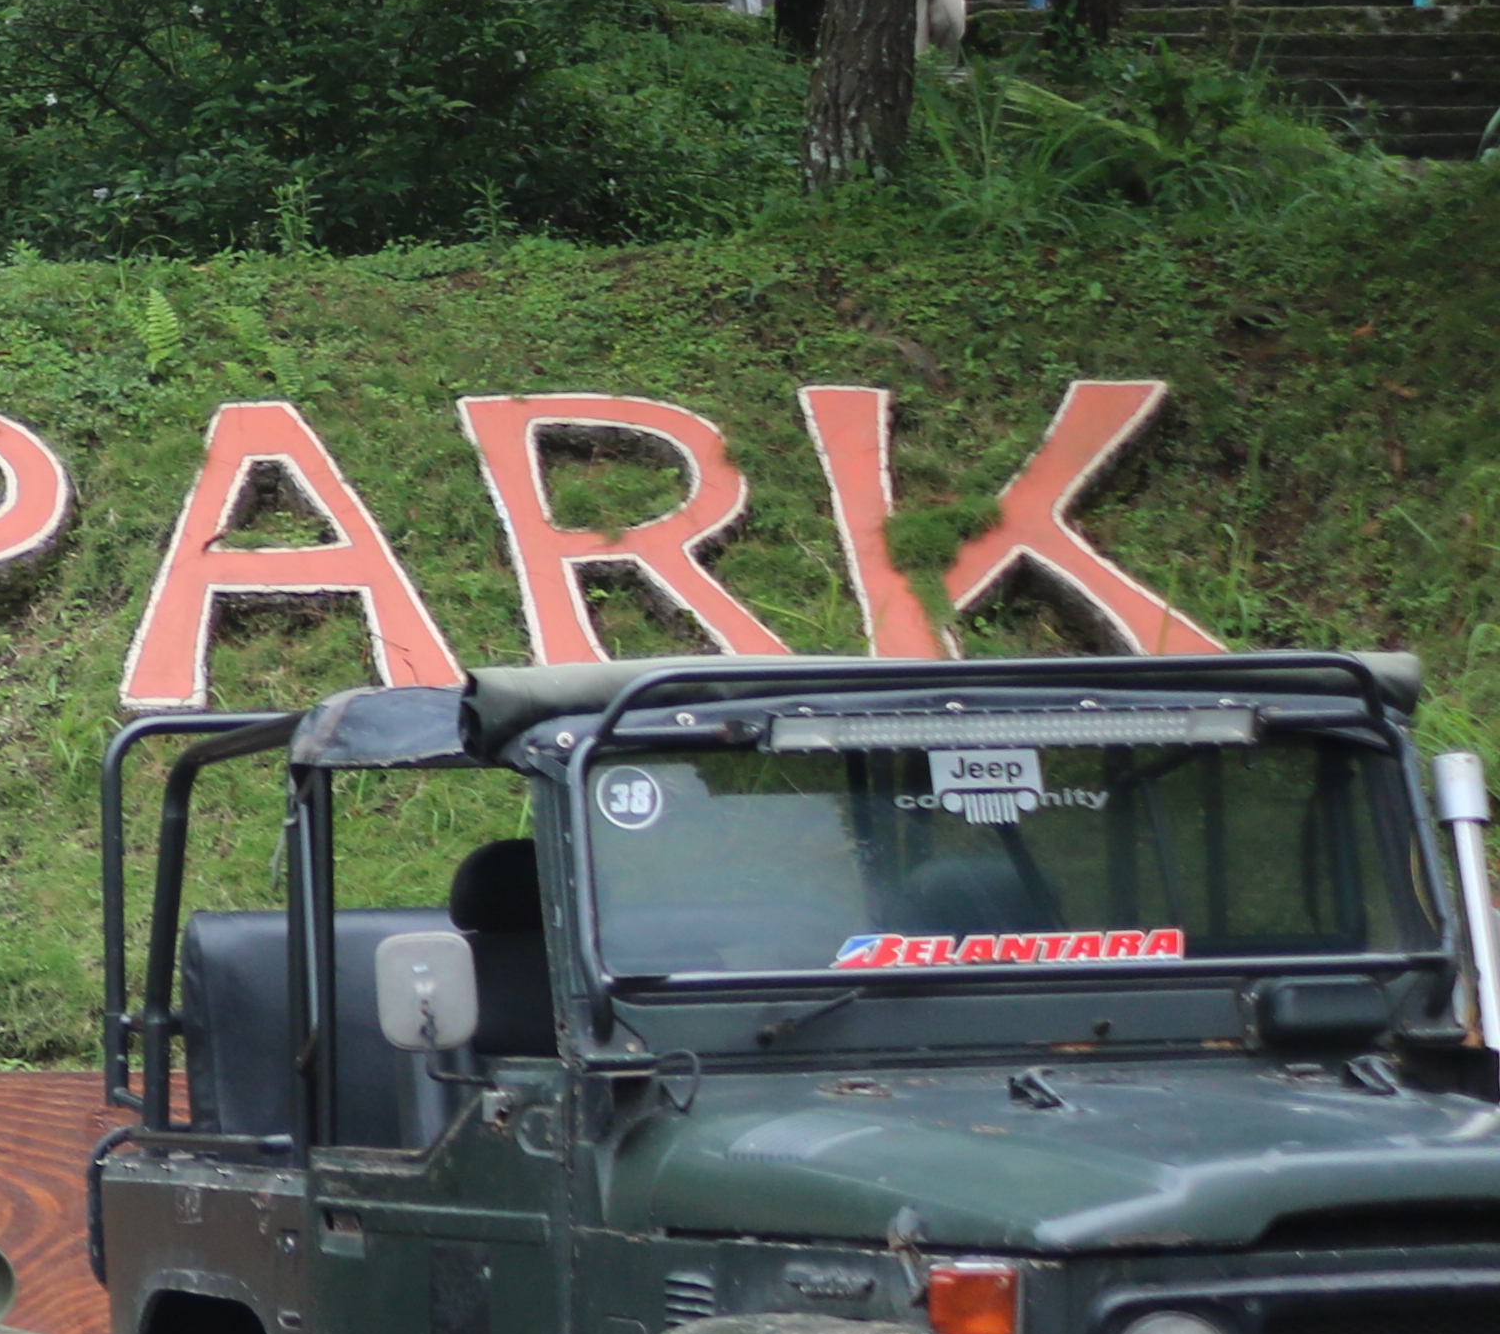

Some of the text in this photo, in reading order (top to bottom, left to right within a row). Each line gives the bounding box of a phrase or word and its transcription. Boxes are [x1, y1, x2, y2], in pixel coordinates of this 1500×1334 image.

[949, 756, 1023, 782] Jeep
[610, 780, 651, 813] 38
[893, 787, 1110, 810] conity
[830, 928, 1185, 969] BELANTARA
